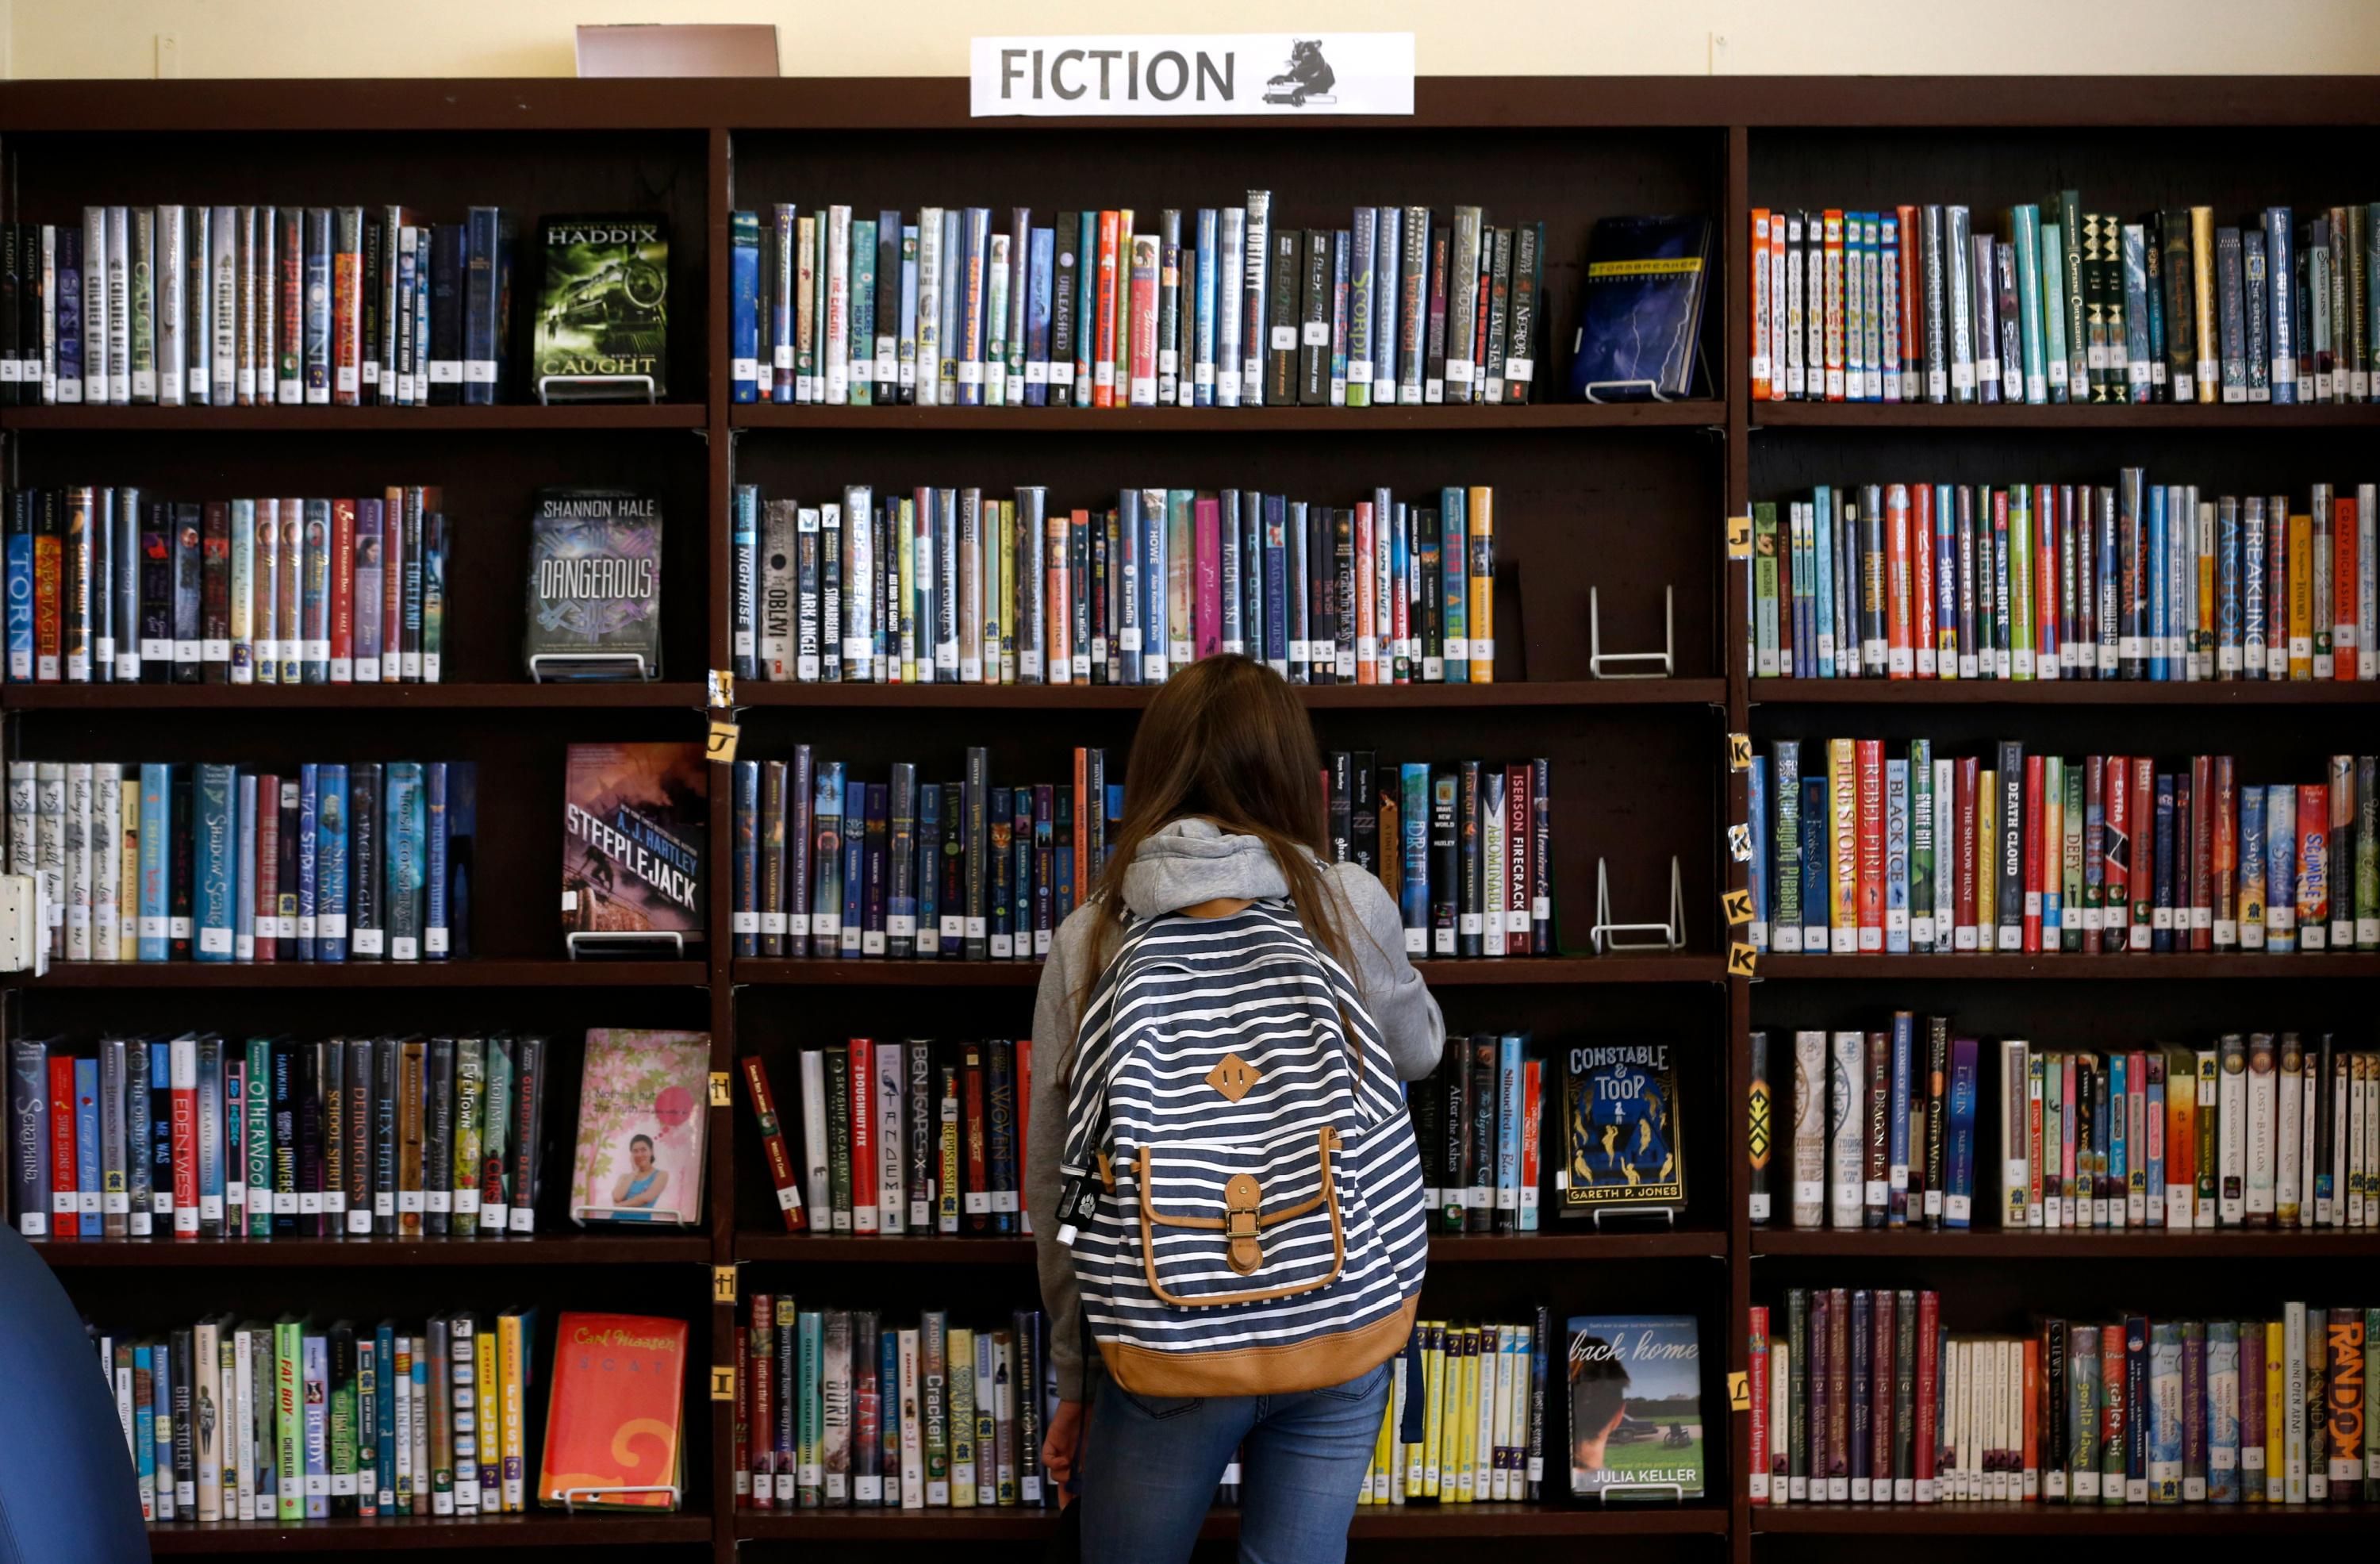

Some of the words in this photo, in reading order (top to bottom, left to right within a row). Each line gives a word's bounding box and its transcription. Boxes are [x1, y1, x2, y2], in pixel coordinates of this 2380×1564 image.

[1000, 49, 1234, 101] FICTION
[547, 229, 658, 245] HADDIX
[1246, 223, 1264, 291] MORIARTY
[1928, 253, 1940, 312] WORLD
[135, 262, 150, 370] CAUGHT
[1057, 275, 1069, 350] UNLEASHED
[1491, 312, 1503, 336] EVIL
[542, 358, 657, 375] CAUGHT
[1488, 344, 1500, 370] STAR
[544, 500, 612, 517] SHANNON
[619, 499, 654, 517] HALE
[2340, 507, 2351, 546] CRAZY
[1150, 530, 1158, 564] HOWE
[1729, 528, 1750, 545] J
[540, 559, 653, 598] DANGEROUS
[1962, 532, 1971, 612] ZOOBREAK
[2341, 549, 2351, 578] RICH
[10, 553, 29, 651] TORN
[40, 544, 54, 656] SABOTAGED
[739, 548, 749, 624] NIGHTRISE
[801, 593, 816, 615] ARK
[1940, 558, 1954, 611] slacker
[2297, 581, 2307, 621] TOTORO
[2341, 582, 2351, 624] ASIANS
[824, 588, 841, 644] STORMBREAKER
[1077, 603, 1086, 615] The
[1125, 596, 1134, 624] misfits
[800, 621, 816, 654] ANGEL
[1077, 618, 1086, 644] Misfits
[707, 732, 735, 752] J
[1734, 742, 1750, 761] K
[1837, 759, 1854, 805] FIRE
[1862, 763, 1879, 827] REBEL
[2069, 775, 2079, 818] LARSON
[2113, 780, 2123, 823] EXTRA
[1513, 775, 1524, 832] ISERSON
[1890, 780, 1903, 845] BLACK
[2007, 782, 2019, 828] DEATH
[566, 803, 697, 912] STEEPLEJACK
[1407, 821, 1426, 886] DRIFT
[1837, 811, 1855, 883] STORM
[1863, 835, 1880, 881] FIRE
[1890, 851, 1903, 882] ICE
[1964, 827, 1972, 869] SHADOW
[2007, 831, 2019, 875] CLOUD
[2066, 834, 2080, 873] DEFY
[2305, 833, 2322, 898] SCUMBLE
[1727, 896, 1753, 918] K
[1732, 948, 1755, 970] K
[276, 1054, 288, 1101] HAWKING
[1569, 1045, 1669, 1074] CONSTABLE
[1614, 1063, 1627, 1078] &
[133, 1078, 144, 1102] THE
[711, 1078, 729, 1100] H
[835, 1076, 846, 1122] SKYSHIP
[856, 1073, 866, 1129] DOUGHNUT
[1449, 1085, 1461, 1117] After
[1503, 1068, 1514, 1130] Silhouetted
[1595, 1075, 1645, 1101] TOOP
[1898, 1078, 1905, 1089] OF
[2256, 1086, 2267, 1112] LOST
[156, 1121, 169, 1136] MR.
[175, 1098, 190, 1150] EDEN
[378, 1098, 391, 1135] HEX
[521, 1076, 533, 1142] GUARDIAN
[1449, 1120, 1460, 1134] the
[1874, 1089, 1887, 1147] DRAGON
[134, 1105, 145, 1164] OBSIDIAN
[156, 1143, 170, 1163] WAS
[857, 1130, 866, 1147] FIX
[2257, 1121, 2267, 1172] BABYLON
[378, 1143, 390, 1189] HALL
[519, 1156, 531, 1189] DEAD
[838, 1128, 847, 1183] ACADEMY
[943, 1124, 956, 1194] REPOSSESSED
[1449, 1137, 1461, 1172] Ashes
[1501, 1153, 1514, 1176] Blue
[135, 1167, 146, 1206] BLADE
[175, 1157, 191, 1207] WEST
[1570, 1189, 1619, 1200] GARETH
[1625, 1189, 1635, 1197] P.
[1638, 1186, 1678, 1197] JONES
[574, 1327, 611, 1347] Carl
[1568, 1328, 1627, 1362] back
[1632, 1329, 1700, 1361] home
[281, 1359, 292, 1385] FAT
[578, 1356, 663, 1374] SCAT
[712, 1374, 731, 1394] I
[758, 1360, 768, 1379] Castle
[175, 1386, 190, 1419] GIRL,
[282, 1388, 294, 1415] BOY
[758, 1389, 768, 1402] the
[758, 1403, 768, 1412] Air
[927, 1375, 943, 1448] Cracker!
[2078, 1383, 2092, 1425] gorilla
[2109, 1382, 2121, 1429] scarlet
[309, 1410, 323, 1466] BUDDY
[398, 1396, 409, 1446] WITNESS
[415, 1397, 425, 1447] WITNESS
[483, 1396, 496, 1458] FLUSH
[506, 1383, 518, 1457] FLUSH
[177, 1424, 191, 1470] STOLEN
[2080, 1431, 2092, 1467] dawn
[2109, 1435, 2122, 1456] ibis
[1593, 1469, 1635, 1483] JULIA
[1639, 1469, 1696, 1481] KELLER
